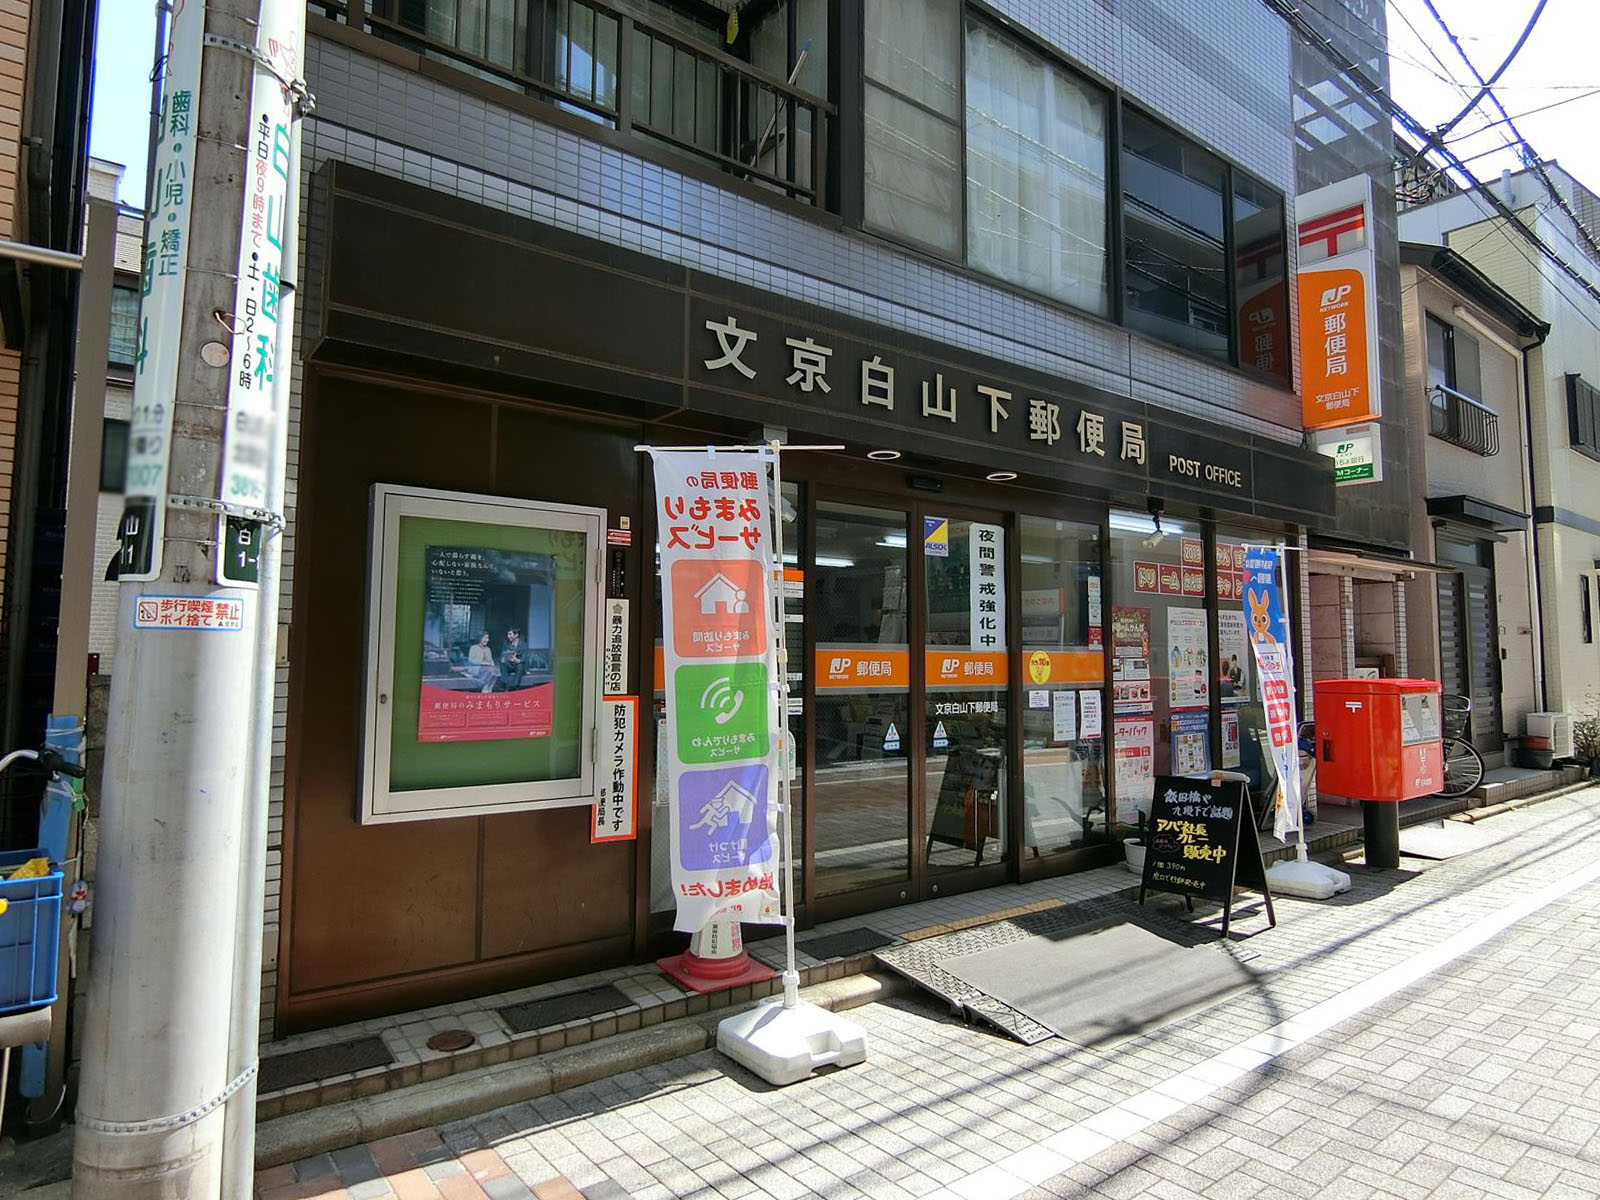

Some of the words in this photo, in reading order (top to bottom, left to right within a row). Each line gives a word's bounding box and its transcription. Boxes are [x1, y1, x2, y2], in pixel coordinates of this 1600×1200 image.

[1319, 301, 1350, 313] NETWORK
[1324, 312, 1347, 378] 郵便局
[703, 315, 1147, 466] 文京白山下郵便局
[1314, 386, 1360, 405] 文京白山下
[1169, 453, 1201, 477] POST
[1205, 464, 1242, 488] OFFICE
[1335, 467, 1369, 476] Mコーナー
[978, 529, 997, 647] 夜間警戒強化中
[160, 599, 214, 613] 歩行喫煙
[215, 602, 240, 620] 禁止
[160, 614, 212, 626] ポイ捨て
[610, 615, 623, 691] 暴力追放宣言の店
[856, 660, 892, 677] 郵便局
[964, 660, 994, 677] 郵便局
[433, 699, 541, 710] 郵便局のみまもりサービス
[935, 701, 998, 715] 文京白山下郵便局
[612, 704, 626, 832] 防犯カメラ作動中です
[1164, 789, 1212, 804] 飯田橋や
[1172, 804, 1233, 820] 九段下で話題
[1156, 819, 1209, 837] アパ社長
[1176, 832, 1209, 845] カレー
[1183, 845, 1227, 864] 販売中
